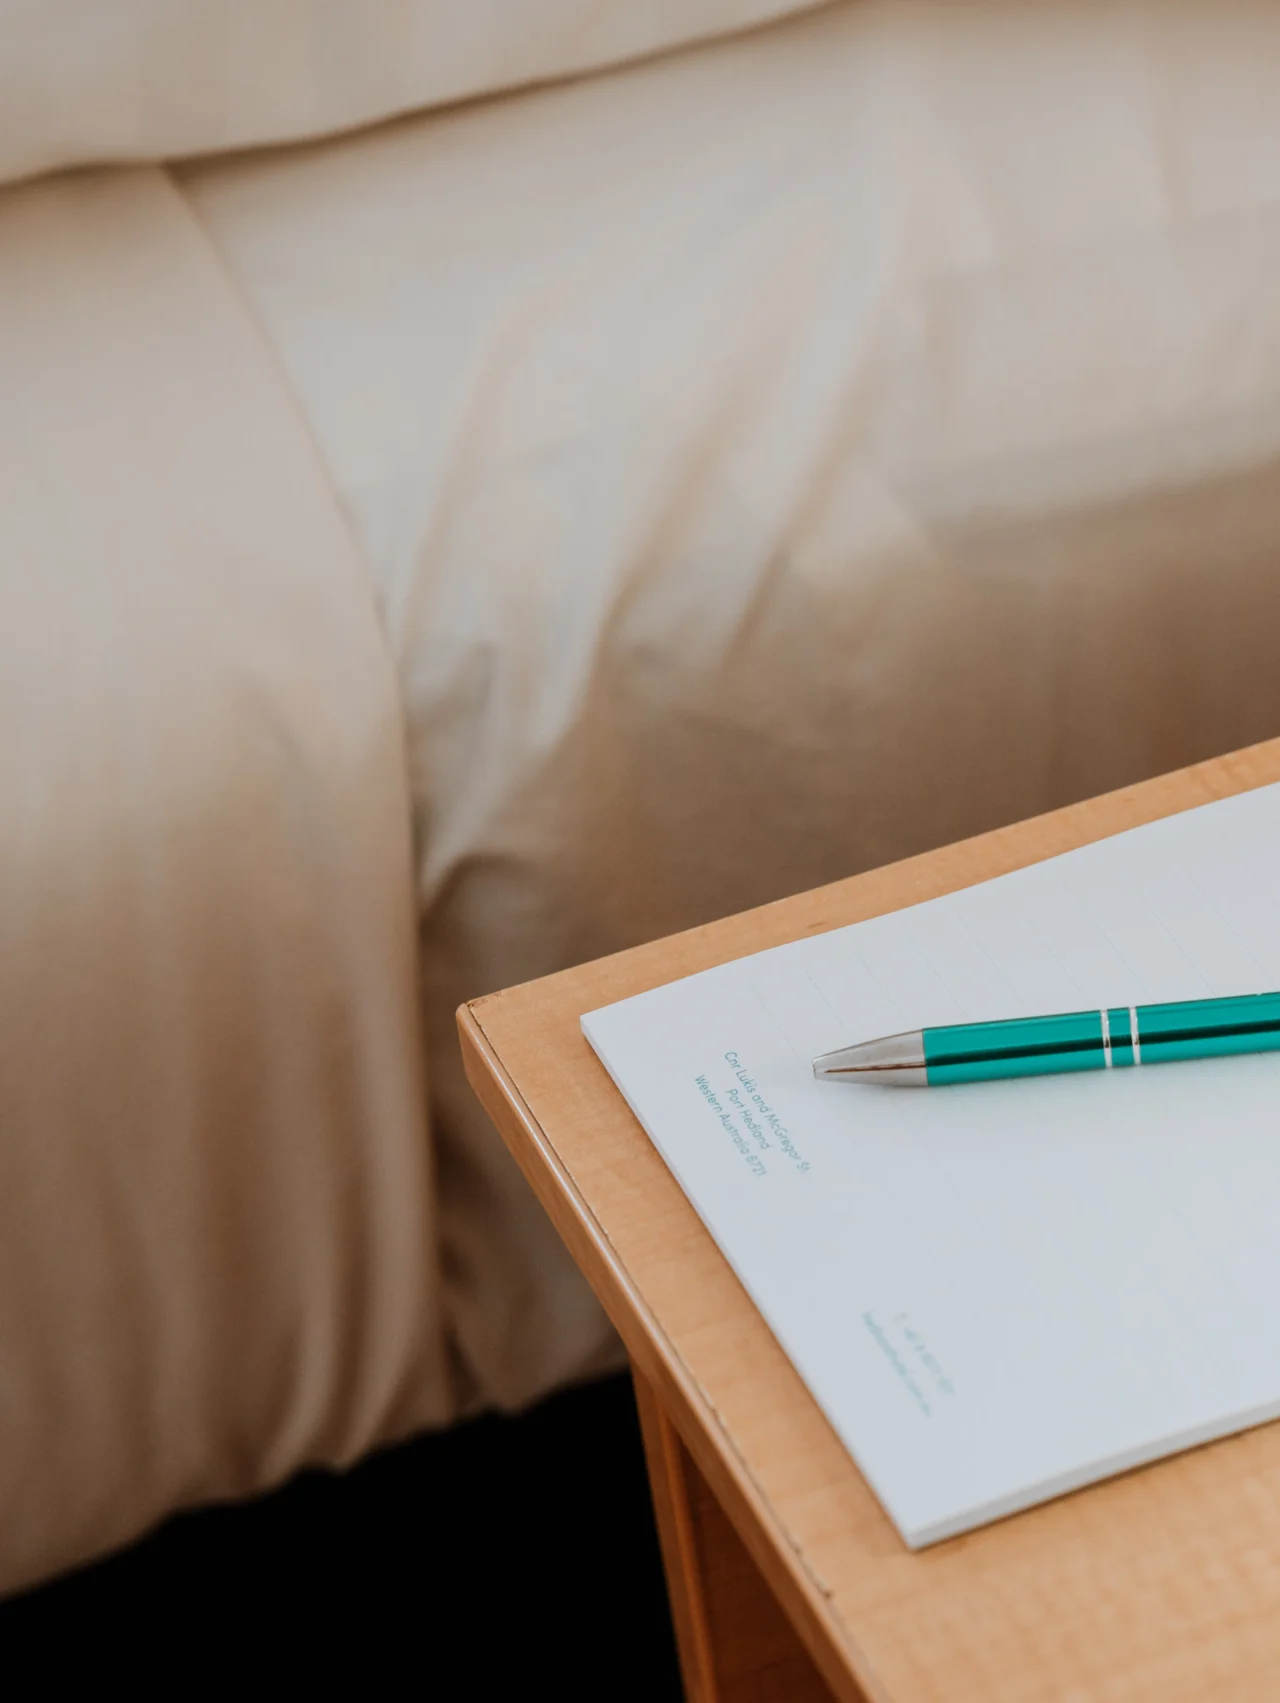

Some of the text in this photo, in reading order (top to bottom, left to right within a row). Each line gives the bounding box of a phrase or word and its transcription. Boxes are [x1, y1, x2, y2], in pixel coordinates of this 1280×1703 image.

[695, 1074, 767, 1176] Western Australia 6721
[725, 1051, 741, 1069] Cnr
[736, 1069, 757, 1093] Lukis
[752, 1095, 771, 1113] and
[764, 1114, 802, 1160] McGregor
[726, 1088, 772, 1150] Port Hedland
